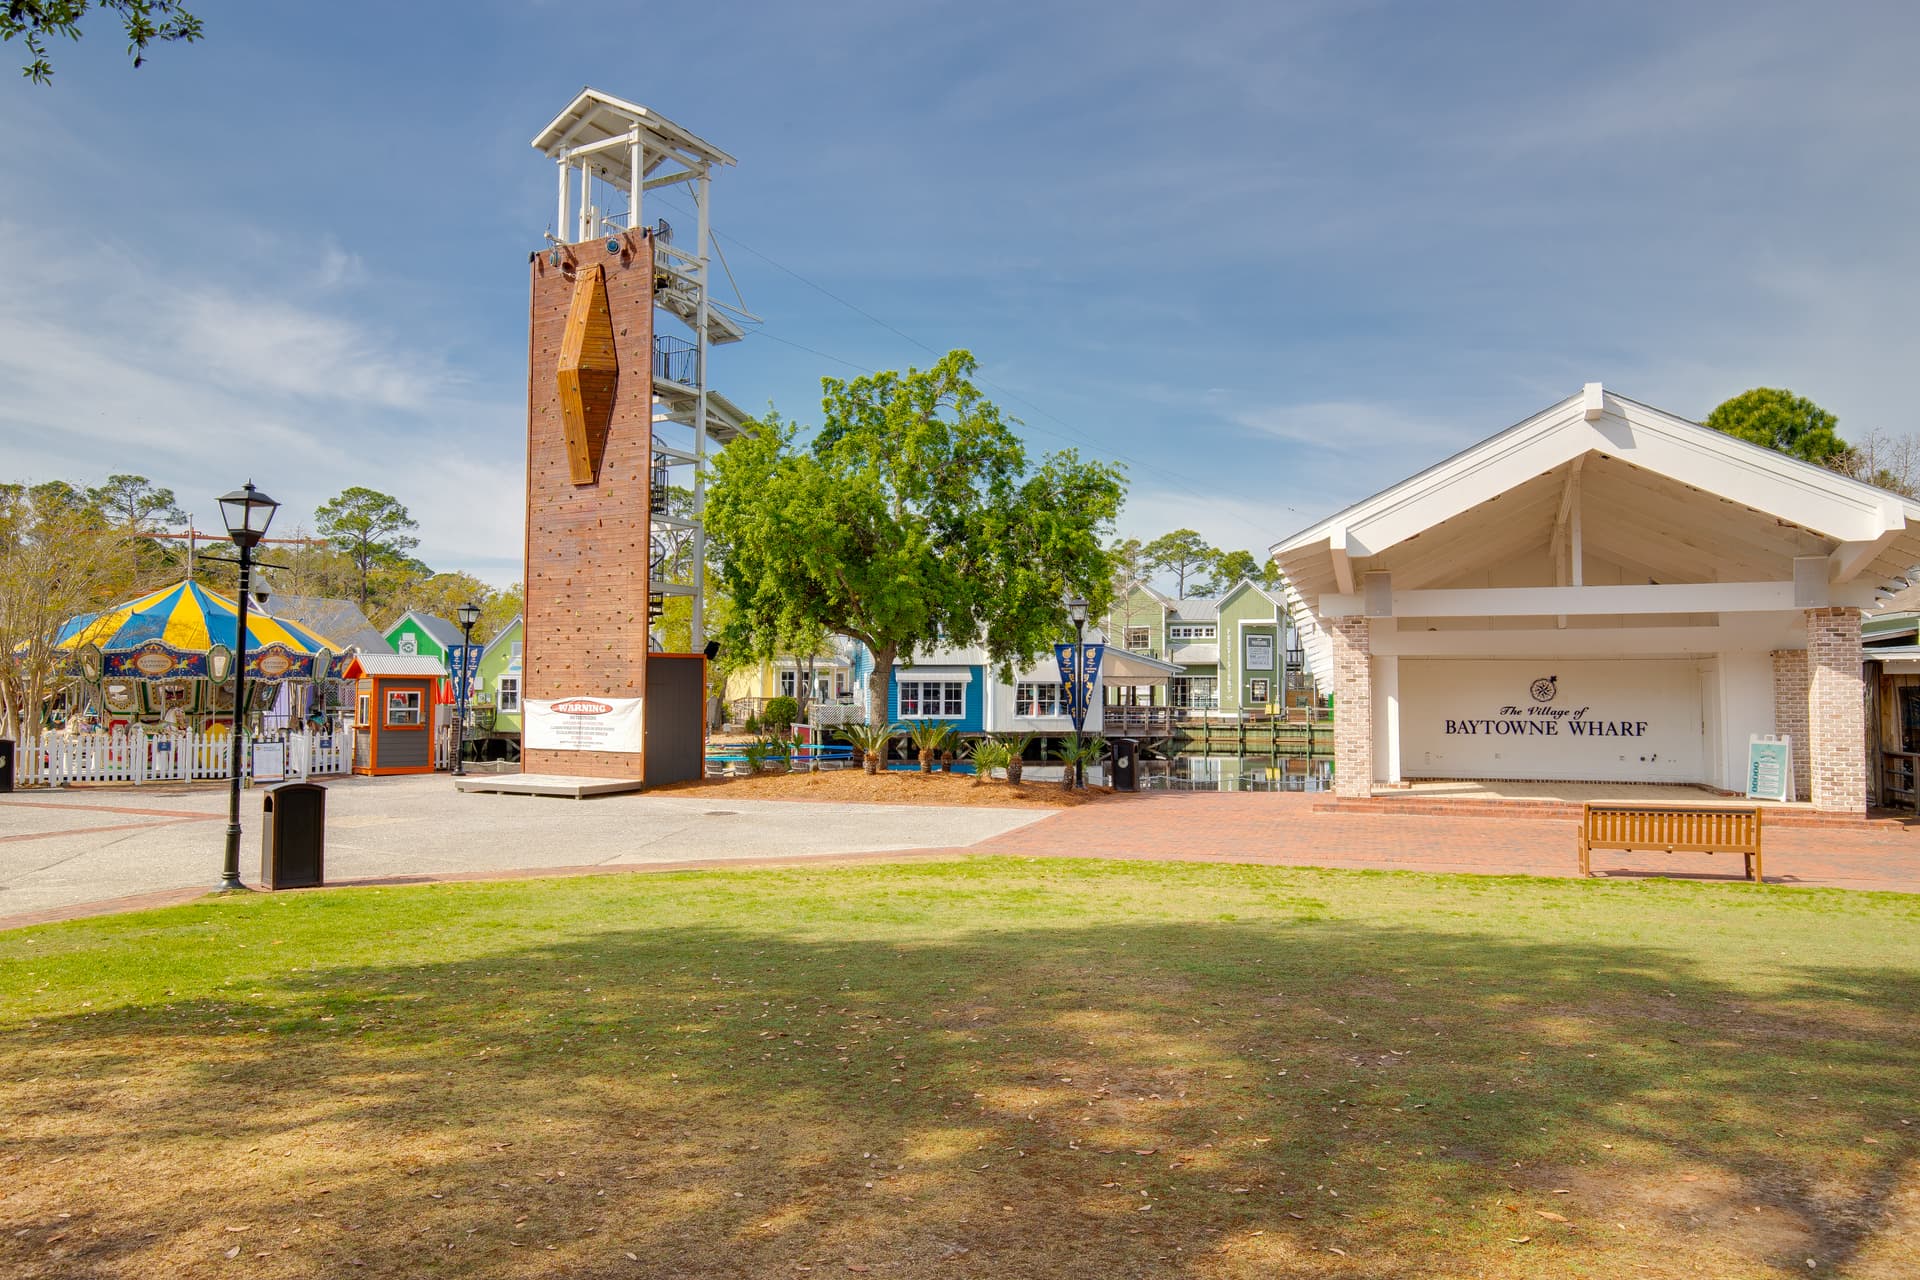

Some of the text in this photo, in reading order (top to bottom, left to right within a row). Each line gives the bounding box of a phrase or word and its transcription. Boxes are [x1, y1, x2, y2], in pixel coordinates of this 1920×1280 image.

[558, 703, 606, 712] WARNING
[1499, 706, 1590, 720] The Village of
[1445, 719, 1649, 737] BAYTOWNE WHARF
